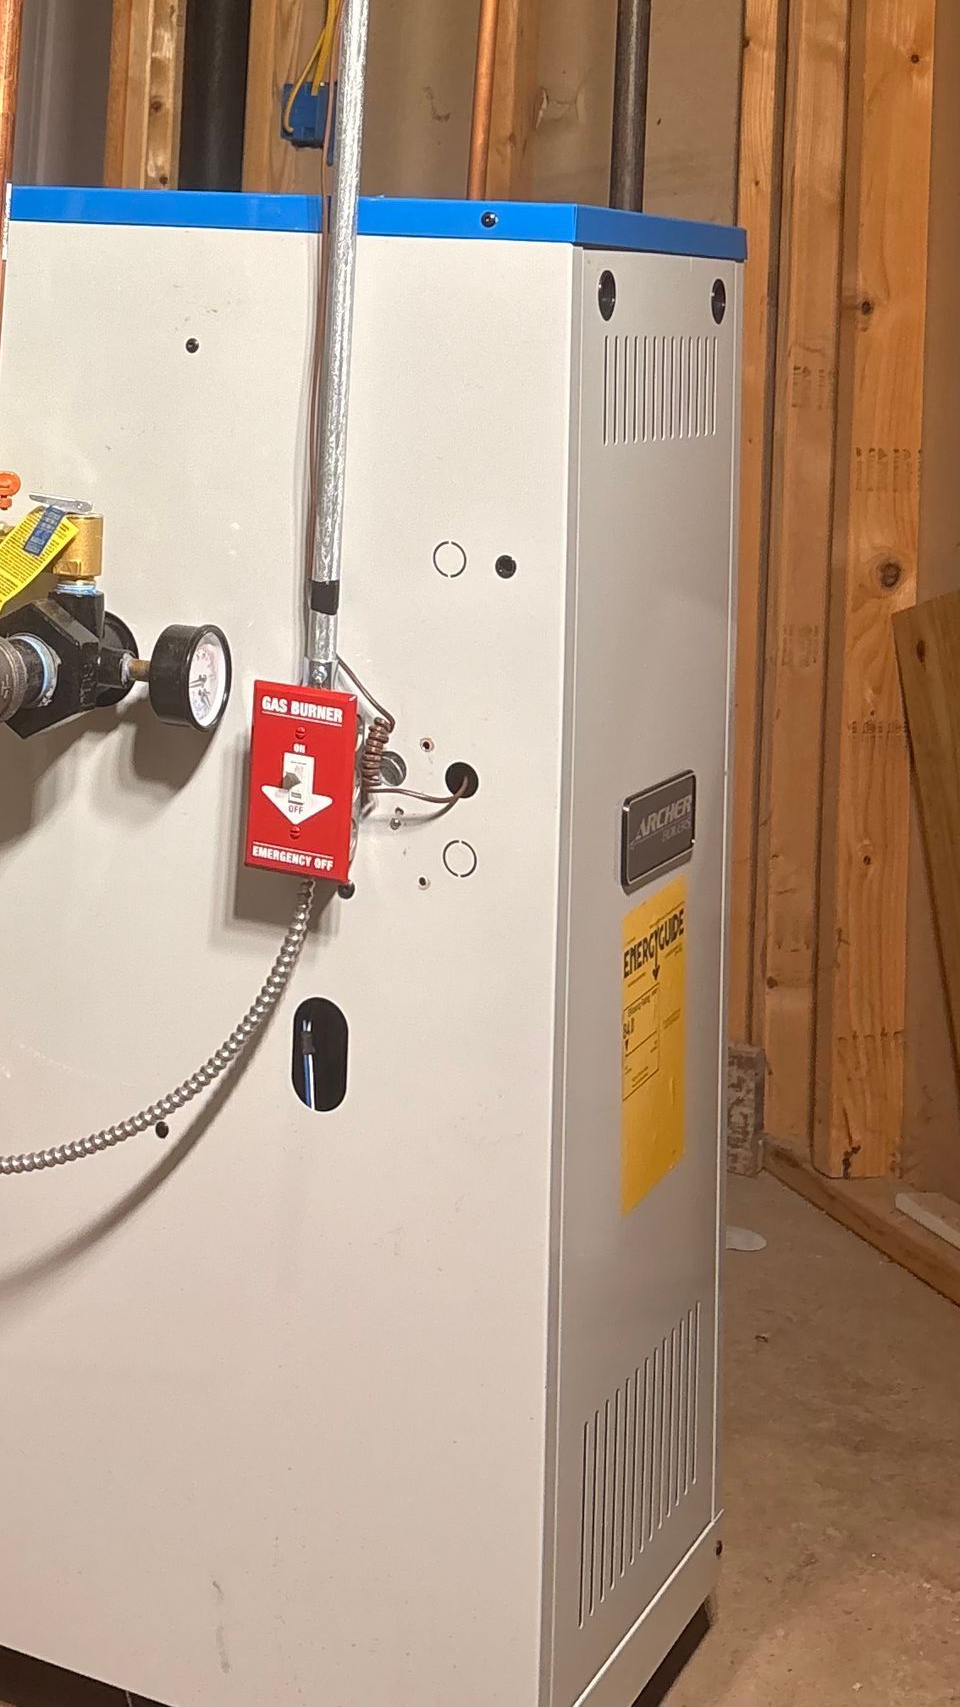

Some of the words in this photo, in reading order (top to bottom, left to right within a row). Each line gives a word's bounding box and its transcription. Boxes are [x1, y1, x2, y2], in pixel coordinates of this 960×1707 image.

[262, 695, 288, 713] GAS
[290, 700, 343, 724] BURNER
[293, 743, 306, 754] ON
[288, 805, 303, 815] OFF
[636, 795, 692, 839] ARCHER
[252, 845, 313, 868] EMERGENCY
[314, 858, 334, 871] OFF
[624, 908, 684, 980] ENERGYGUIDE
